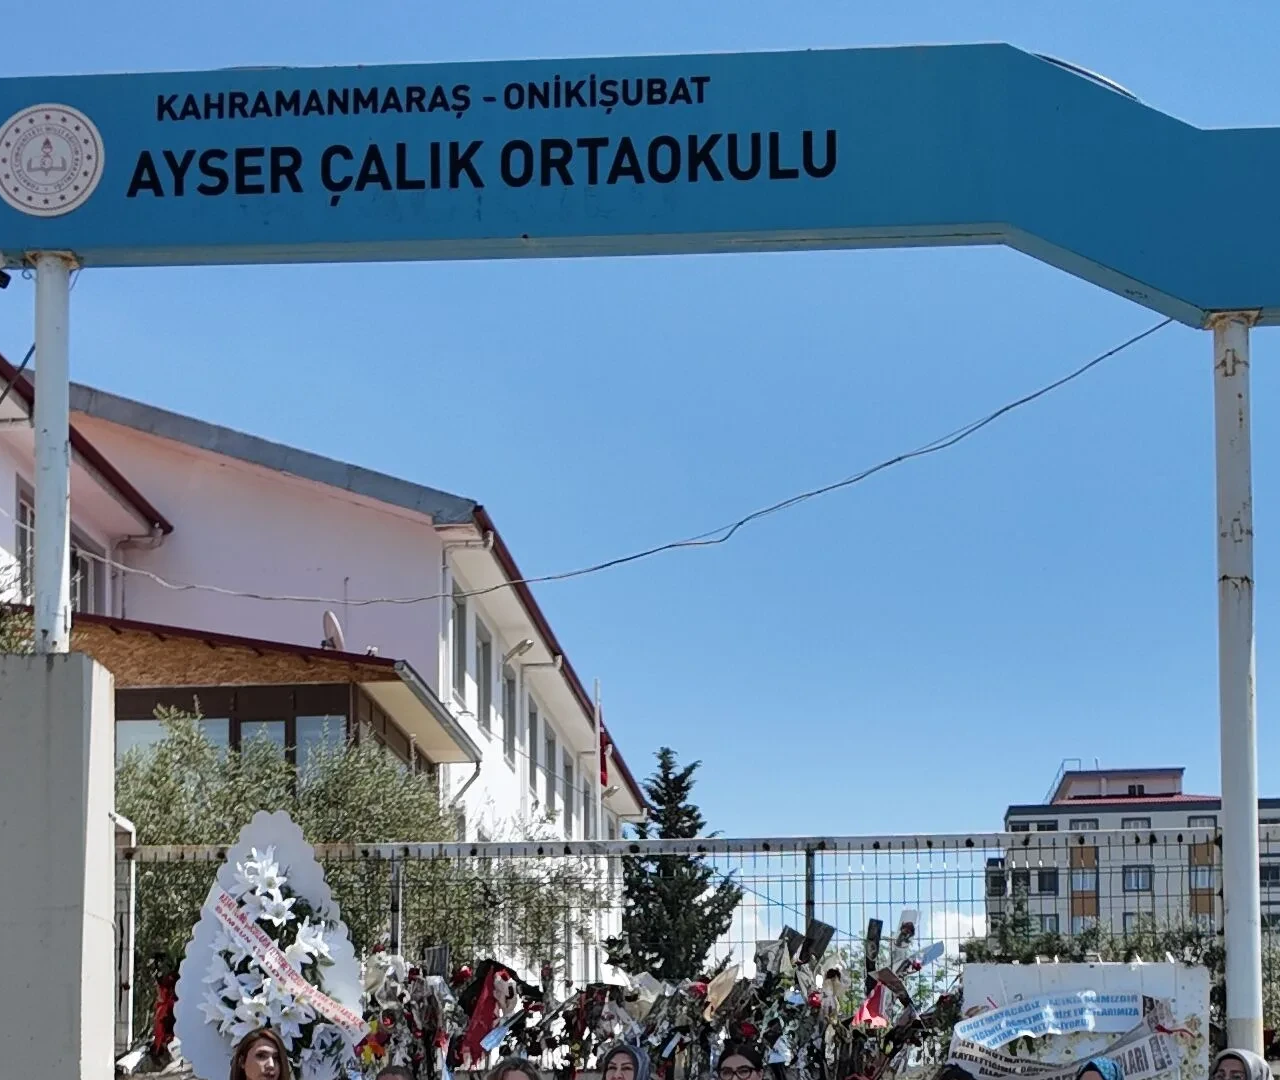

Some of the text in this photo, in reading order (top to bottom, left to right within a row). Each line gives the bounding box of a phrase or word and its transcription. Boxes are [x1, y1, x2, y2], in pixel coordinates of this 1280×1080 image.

[156, 84, 471, 122] KAHRAMANMARAŞ
[503, 74, 711, 115] ONİKİŞUBAT
[126, 146, 304, 198] AYSER
[320, 141, 485, 207] ÇALIK
[500, 129, 837, 188] ORTAOKULU
